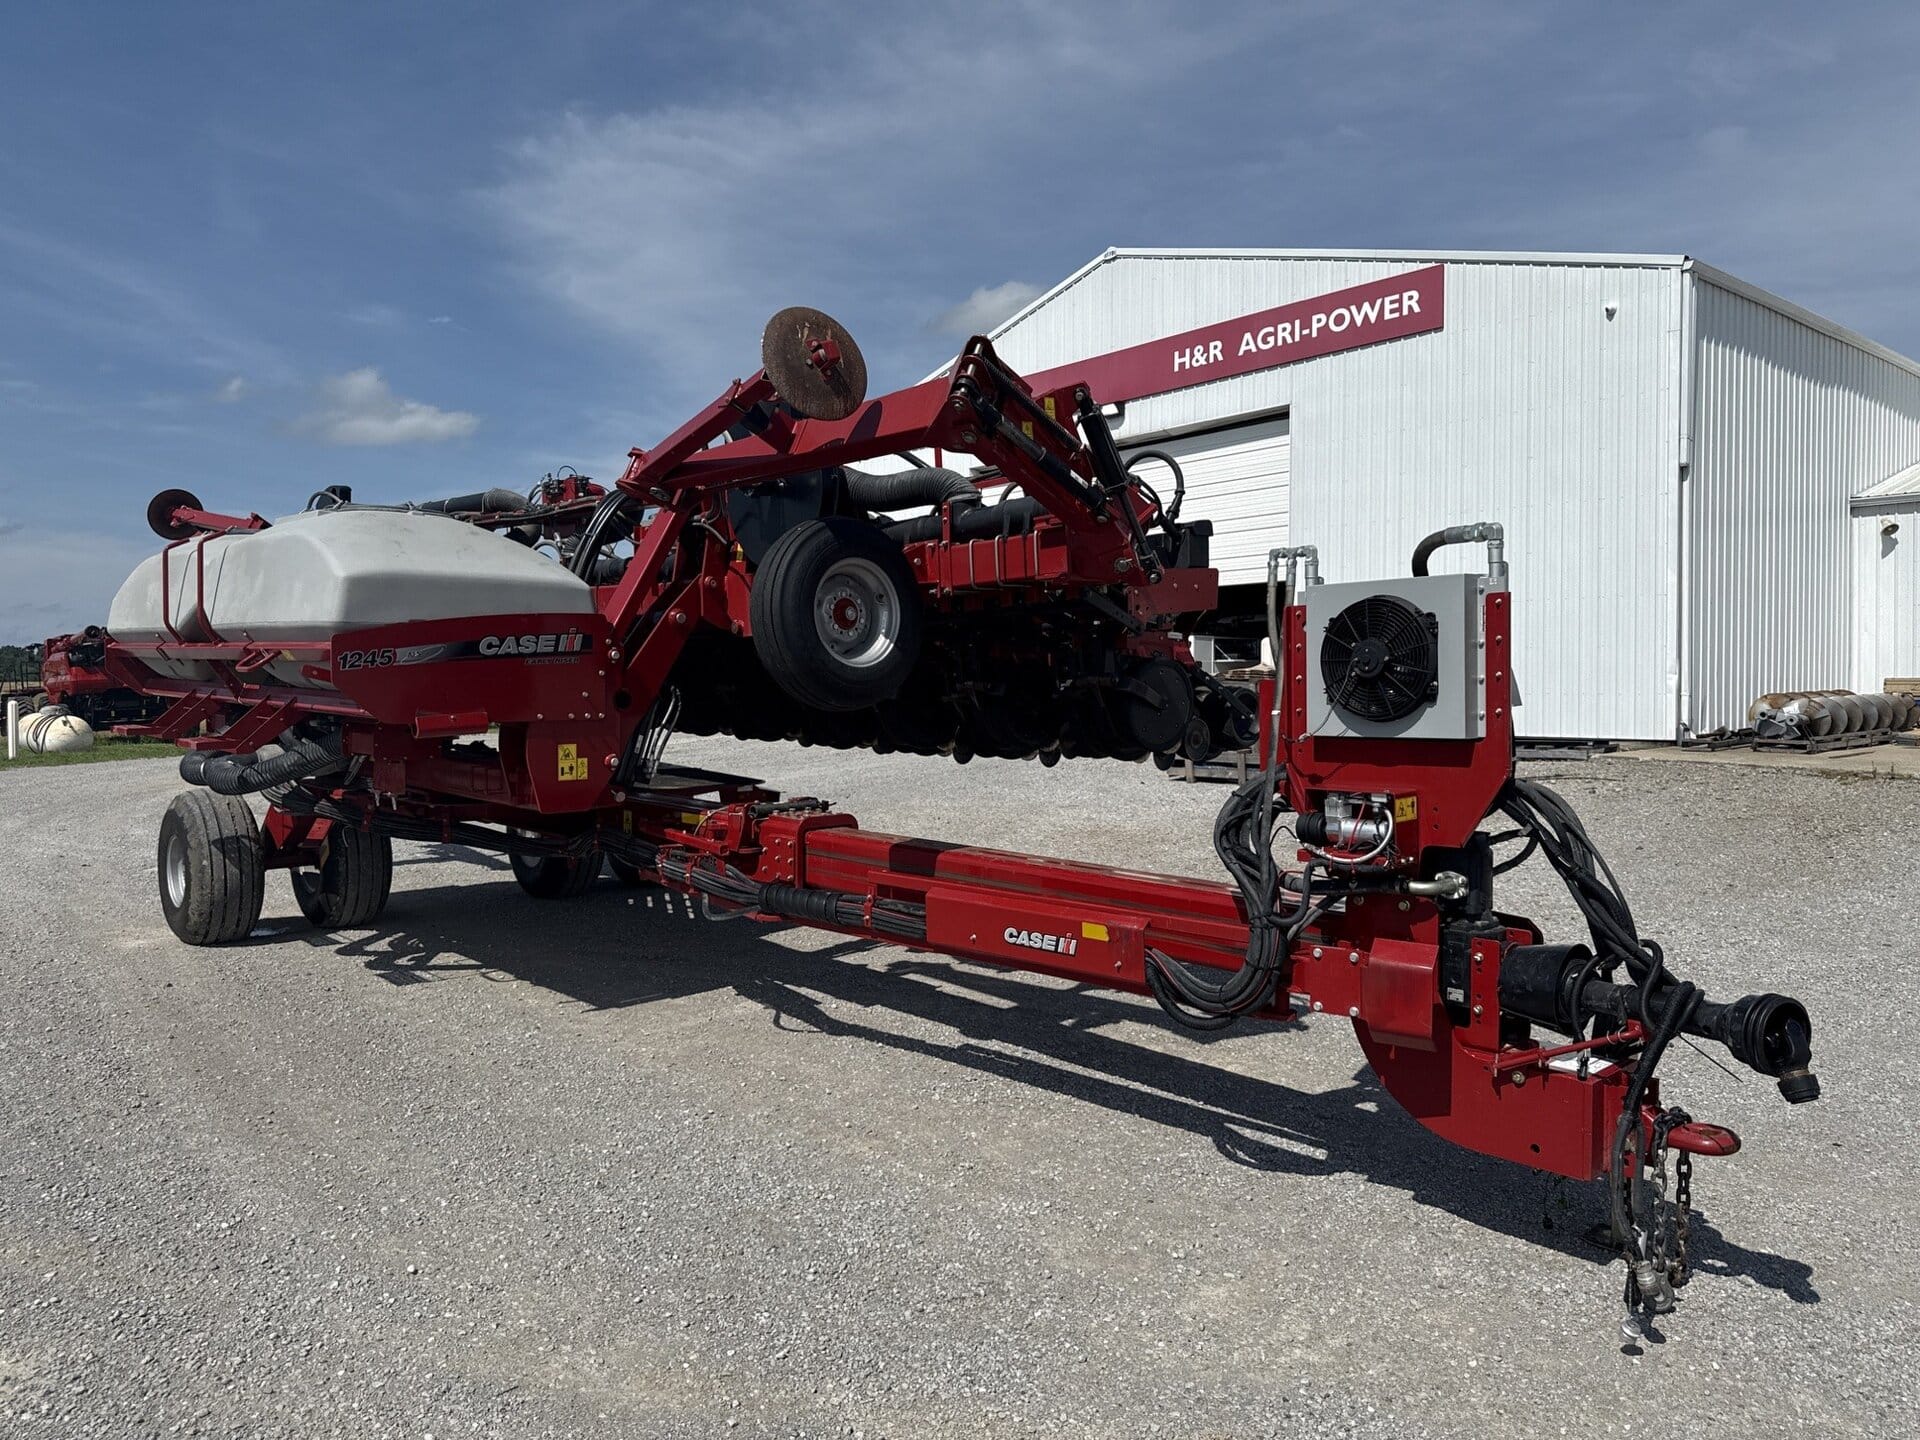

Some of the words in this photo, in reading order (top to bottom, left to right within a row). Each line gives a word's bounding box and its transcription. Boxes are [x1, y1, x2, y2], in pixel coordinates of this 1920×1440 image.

[1173, 340, 1224, 372] H&R
[1238, 290, 1421, 356] AGRI-POWER
[479, 635, 557, 655] CASE
[338, 648, 394, 670] 1245
[1004, 927, 1057, 951] CASE
